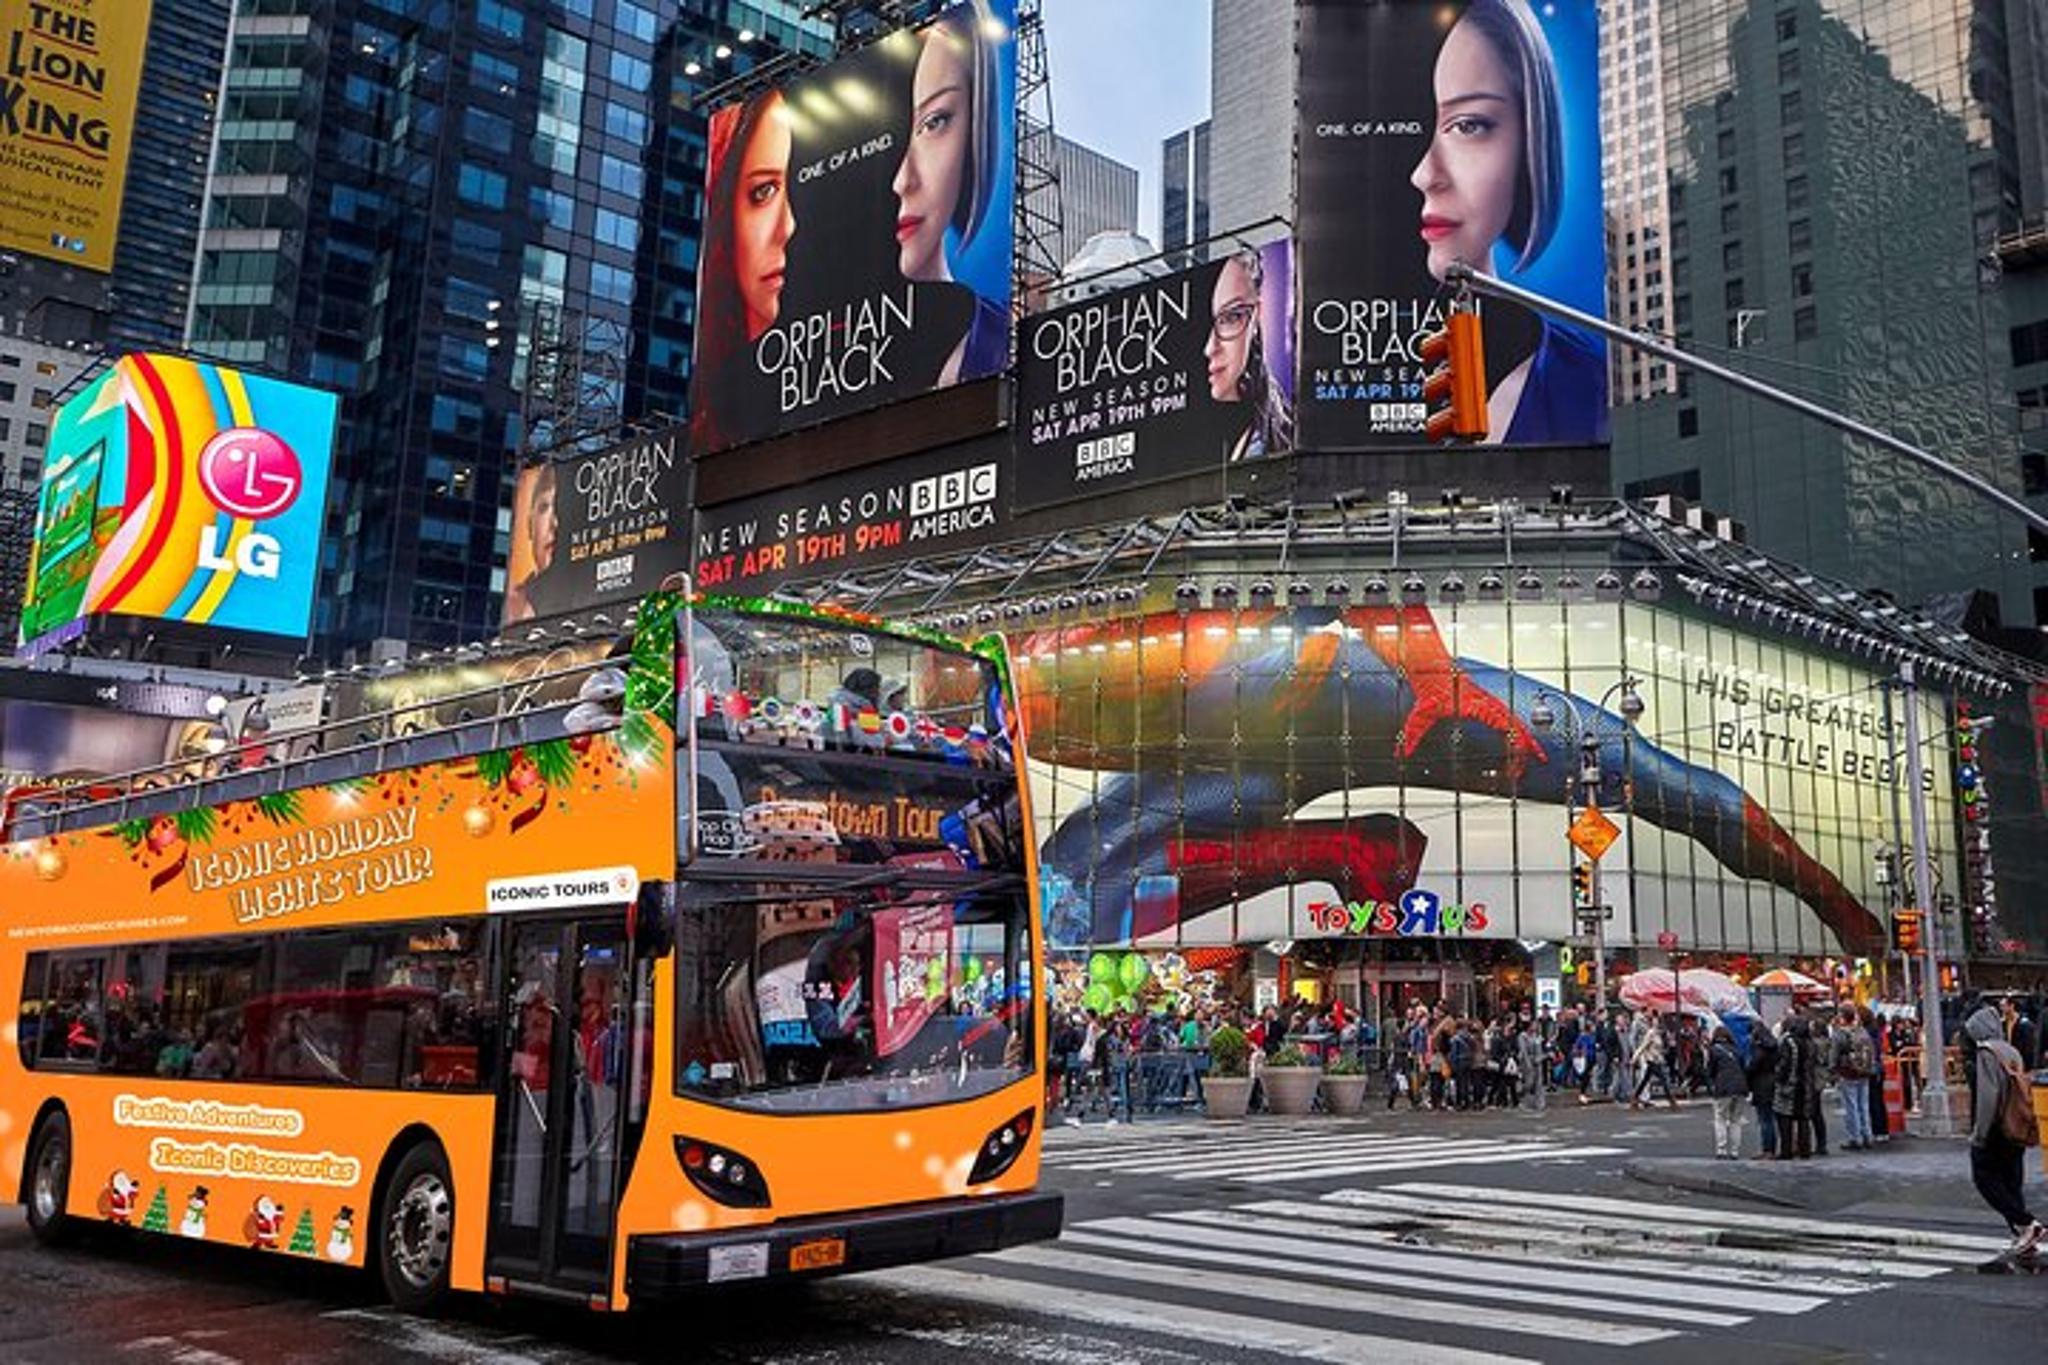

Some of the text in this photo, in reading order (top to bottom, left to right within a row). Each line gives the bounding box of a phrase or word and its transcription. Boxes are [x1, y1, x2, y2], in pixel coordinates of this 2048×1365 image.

[29, 2, 96, 46] THE
[8, 30, 105, 91] LION
[0, 77, 111, 150] KING
[1353, 122, 1371, 135] OF
[1374, 122, 1386, 135] A
[56, 170, 104, 190] EVENT
[829, 150, 848, 171] OF
[848, 147, 860, 163] A
[756, 283, 914, 374] ORPHAN
[1034, 281, 1190, 359] ORPHAN
[1057, 324, 1169, 393] BLACK
[1342, 330, 1427, 365] BLAC
[781, 335, 894, 412] BLACK
[1315, 369, 1366, 382] NEW
[1316, 385, 1352, 399] SAT
[1354, 384, 1392, 398] APR
[1032, 371, 1187, 424] NEW SEASON
[1032, 393, 1187, 444] SAT APR 19TH 9PM
[1370, 404, 1426, 421] BBC
[1077, 432, 1135, 466] BBC
[1370, 421, 1427, 432] AMERICA
[576, 437, 676, 494] ORPHAN
[1075, 457, 1134, 481] AMERICA
[588, 471, 660, 521] BLACK
[910, 463, 996, 517] BBC
[699, 485, 904, 555] NEW SEASON
[908, 505, 996, 541] AMERICA
[198, 524, 282, 581] LG
[697, 522, 900, 587] SAT APR 19TH 9PM
[1696, 669, 1750, 707] HIS
[1717, 722, 1830, 772] BATTLE
[894, 797, 945, 840] Tour
[188, 806, 418, 893] ICONIC HOLIDAY
[230, 846, 434, 924] LIGHTS TOUR
[491, 880, 610, 901] ICONIC TOURS
[119, 1101, 298, 1131] Festive Adventures
[156, 1143, 355, 1181] Iconic Discoveries
